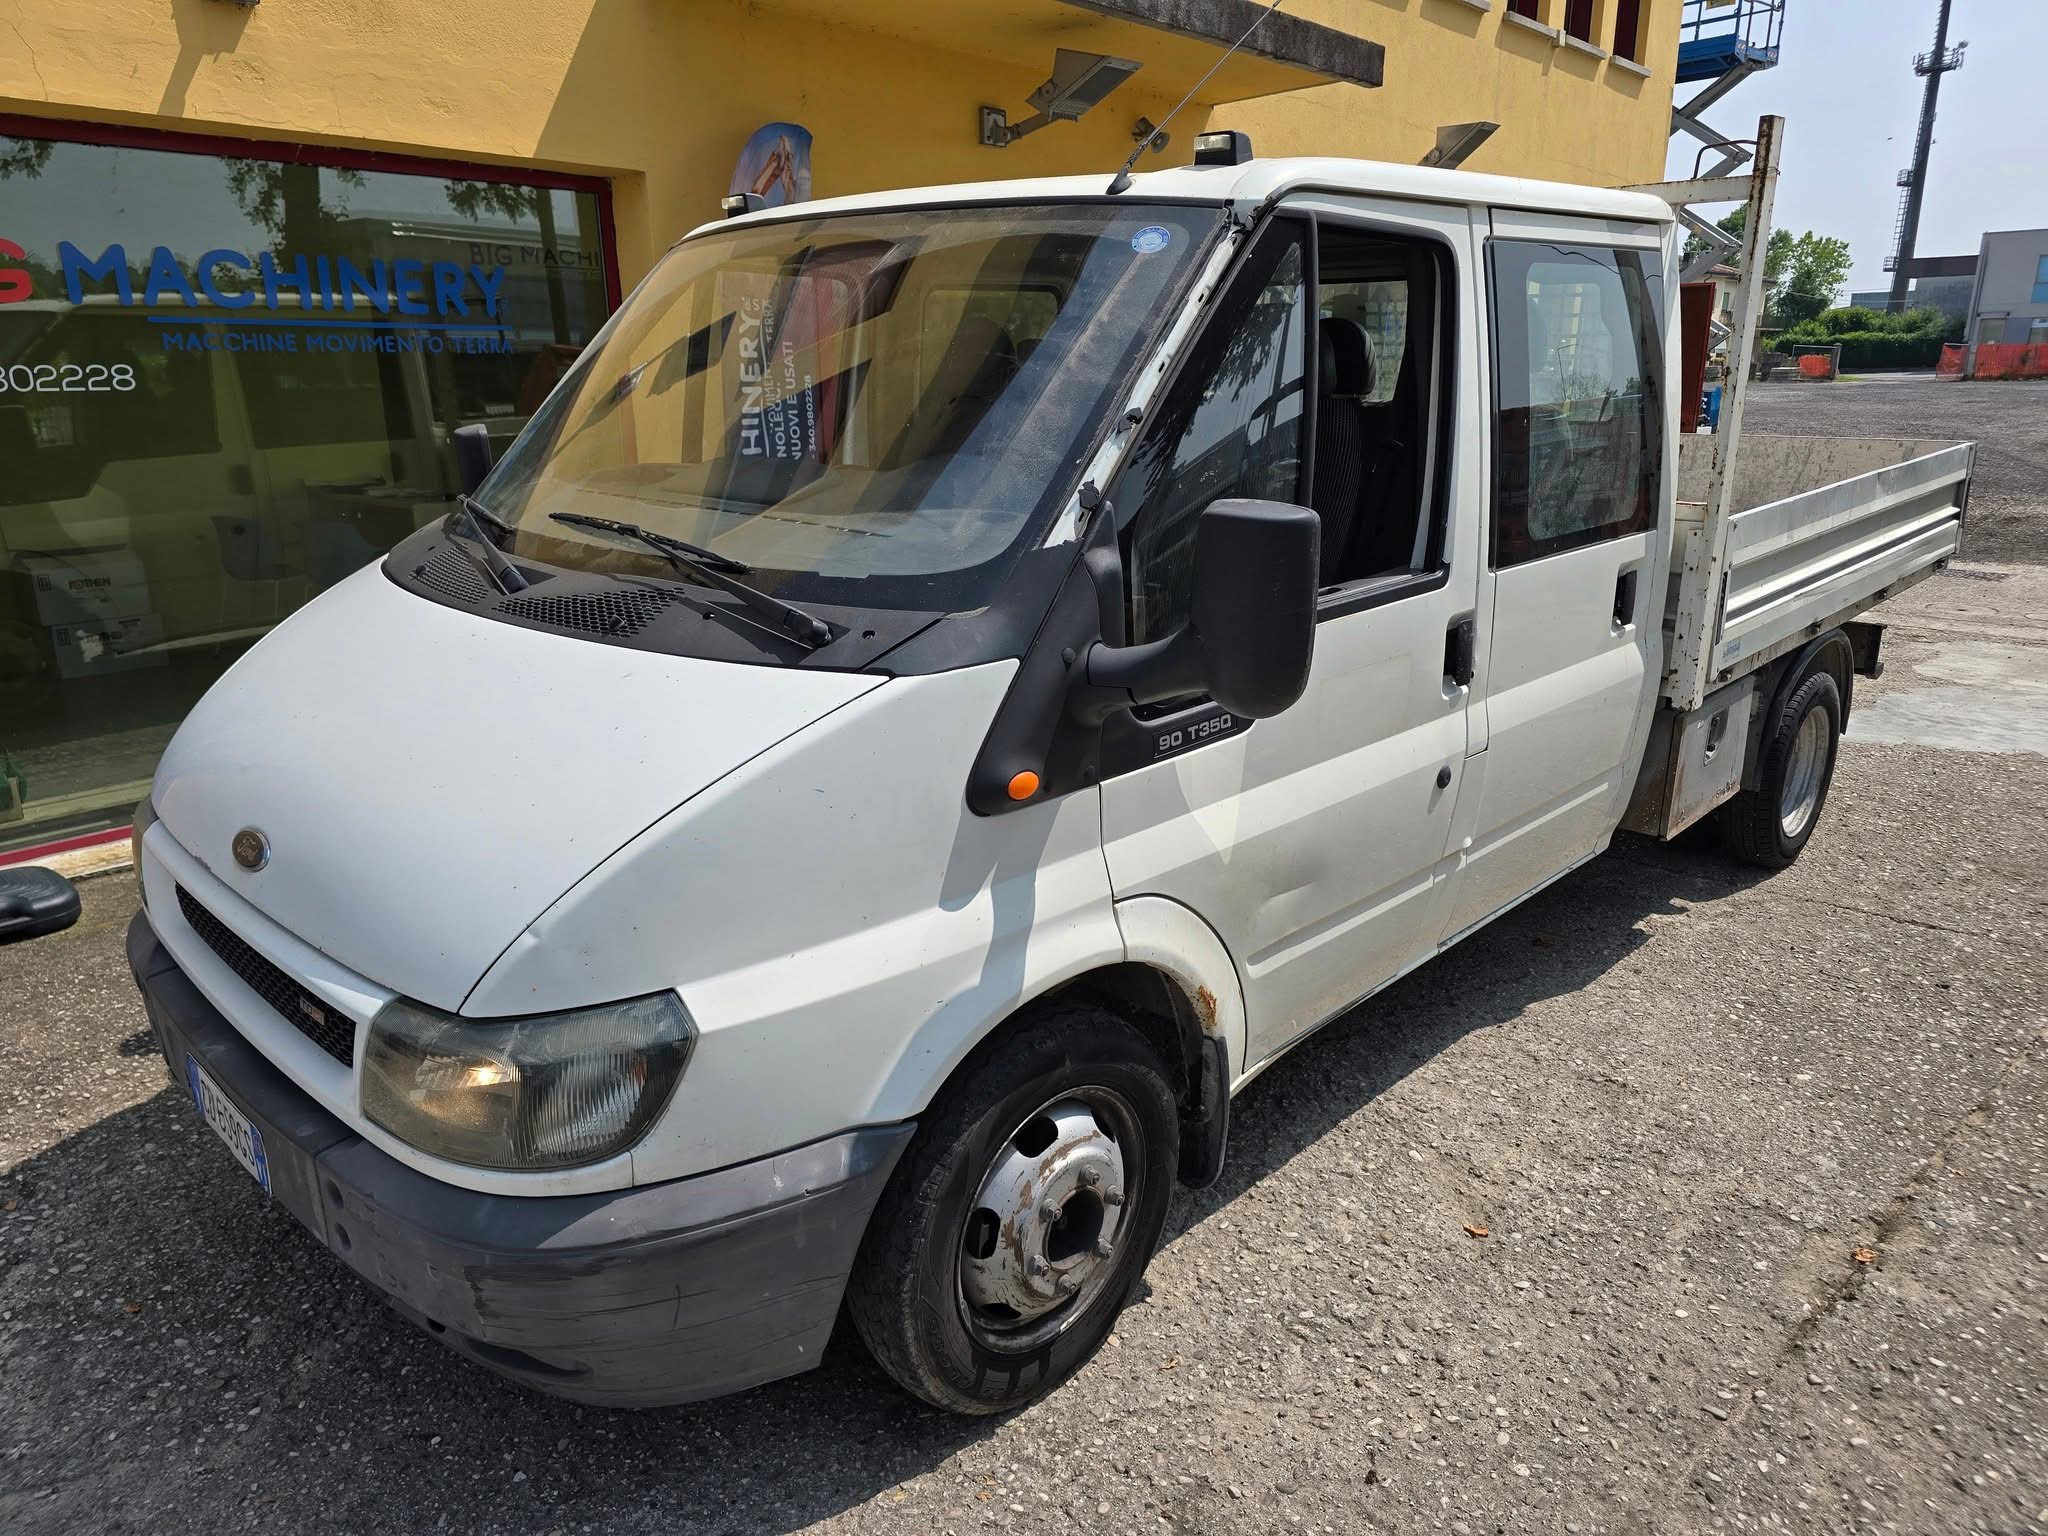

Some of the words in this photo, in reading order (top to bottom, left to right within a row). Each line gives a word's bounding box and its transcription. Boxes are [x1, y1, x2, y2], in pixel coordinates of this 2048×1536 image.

[470, 243, 512, 266] BIG
[58, 240, 504, 318] MACHINERY
[162, 332, 297, 352] MACCHINE
[306, 333, 443, 353] MOVIMENTO
[453, 336, 513, 355] TERRA
[782, 341, 796, 389] USATI
[787, 393, 798, 404] E
[1159, 731, 1183, 750] 90
[1187, 714, 1232, 740] T350
